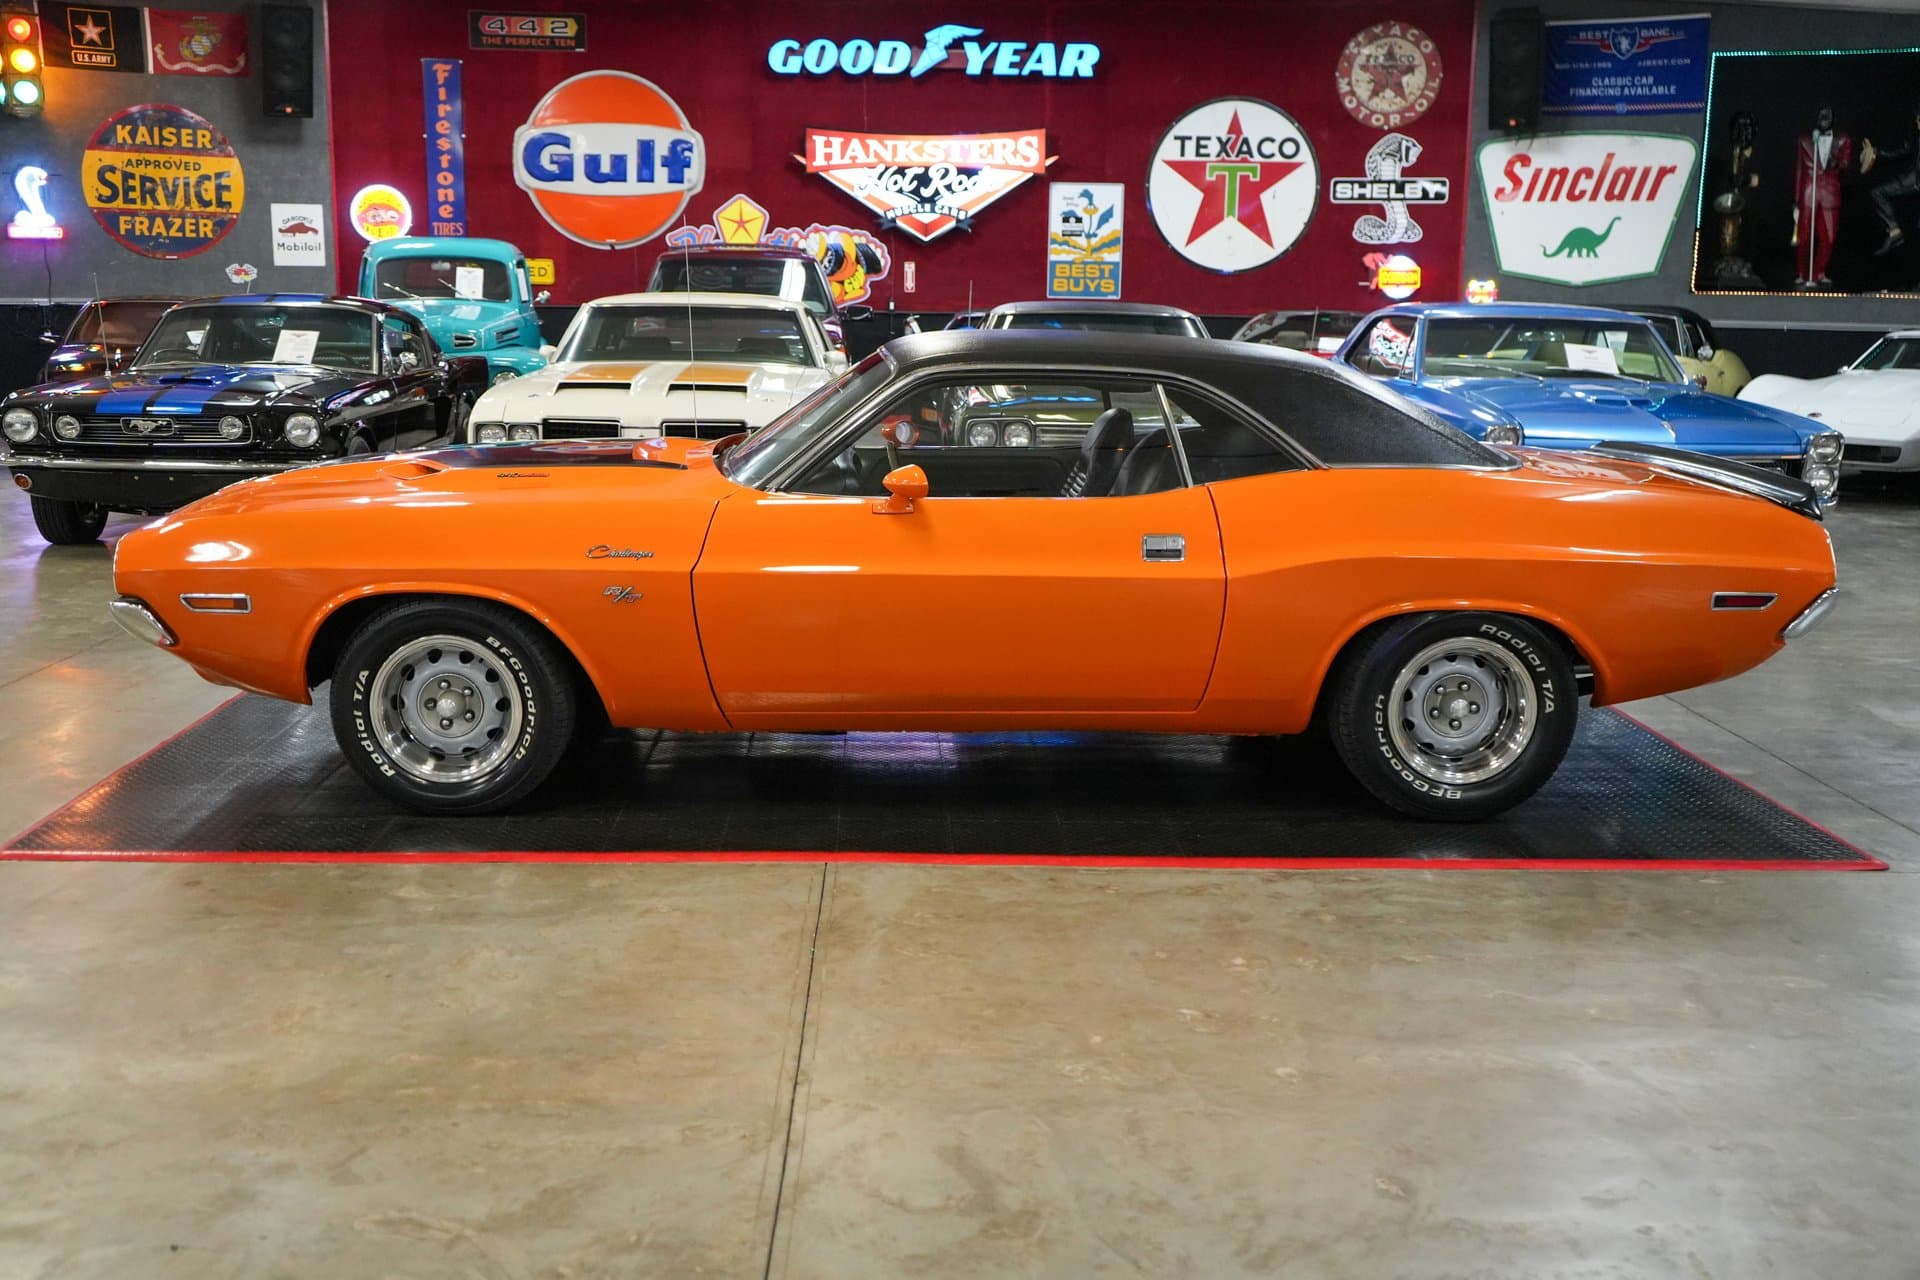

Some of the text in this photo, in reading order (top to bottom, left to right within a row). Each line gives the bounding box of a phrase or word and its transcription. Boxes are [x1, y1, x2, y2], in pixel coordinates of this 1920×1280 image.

[482, 37, 576, 46] THE PERFECT TEN
[1579, 30, 1609, 40] BEST
[76, 53, 111, 64] U.S. ARMY
[767, 38, 1101, 77] GOOD YEAR
[1570, 85, 1677, 96] FINANCING AVAILABLE
[1592, 76, 1654, 86] CLASSIC CAR
[116, 124, 213, 149] KAISER
[431, 63, 456, 219] Firestone
[1173, 135, 1301, 160] TEXACO
[523, 132, 693, 184] Gulf
[811, 134, 1040, 168] HANKSTERS
[125, 158, 202, 172] APPROVED
[1495, 152, 1678, 203] Sinclair
[96, 165, 232, 210] SERVICE
[856, 163, 925, 194] Hot
[1206, 163, 1260, 219] T
[1335, 181, 1441, 200] SHELBY
[885, 203, 967, 220] MUSCLE CARS
[118, 215, 214, 238] FRAZER
[432, 222, 464, 236] TIRES
[277, 242, 322, 252] Mobiloil
[1055, 263, 1114, 278] BEST
[1053, 278, 1115, 293] BUYS
[1480, 623, 1555, 713] Radial T/A
[485, 636, 537, 761] BFGoodrich
[353, 669, 396, 777] Radial T/A
[1375, 694, 1463, 800] BFGoodrich
